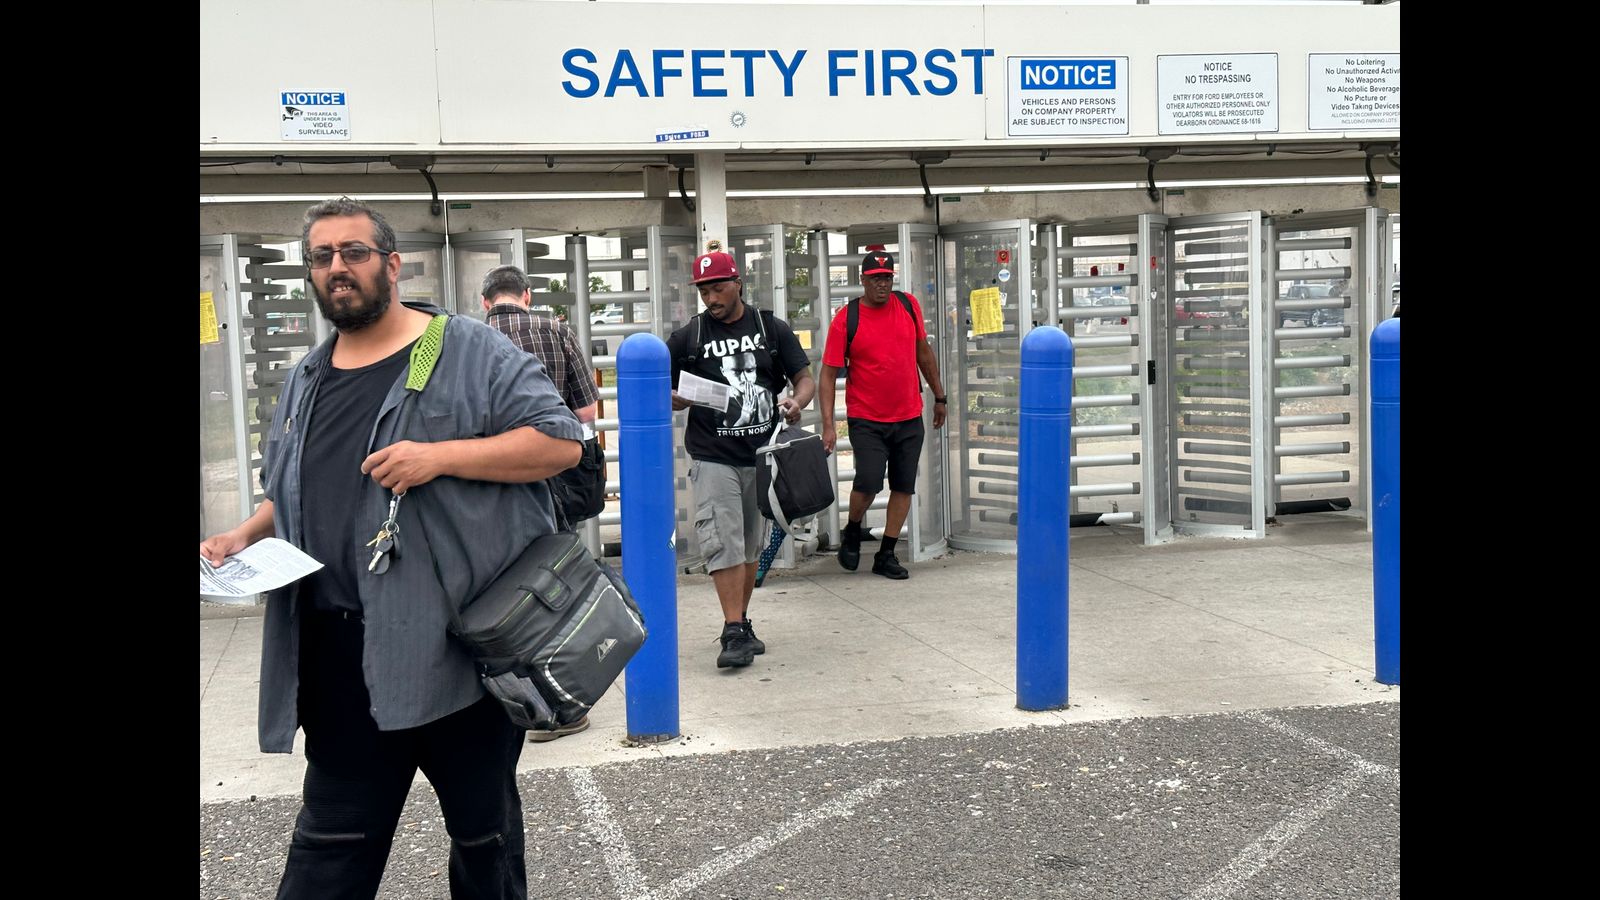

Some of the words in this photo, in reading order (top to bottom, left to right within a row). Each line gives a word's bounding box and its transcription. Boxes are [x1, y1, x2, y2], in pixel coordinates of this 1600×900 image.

[1204, 62, 1232, 71] NOTICE
[1356, 58, 1386, 67] Loitering
[561, 47, 808, 99] SAFETY
[828, 48, 995, 97] FIRST
[1025, 65, 1112, 85] NOTICE
[1185, 75, 1197, 84] NO
[1198, 74, 1252, 84] TRESPASSING
[286, 93, 341, 105] NOTICE
[1166, 102, 1185, 110] OTHER
[1351, 103, 1373, 111] Taking
[1374, 102, 1400, 110] Devices
[1075, 107, 1116, 115] PROPERTY
[1227, 109, 1265, 117] PROSECUTED
[1012, 118, 1028, 126] ARE
[1030, 118, 1065, 126] SUBJECT
[1176, 119, 1207, 127] DEARBORN
[1207, 118, 1240, 126] ORDINANCE
[700, 256, 712, 275] P
[703, 332, 765, 359] TUPAC
